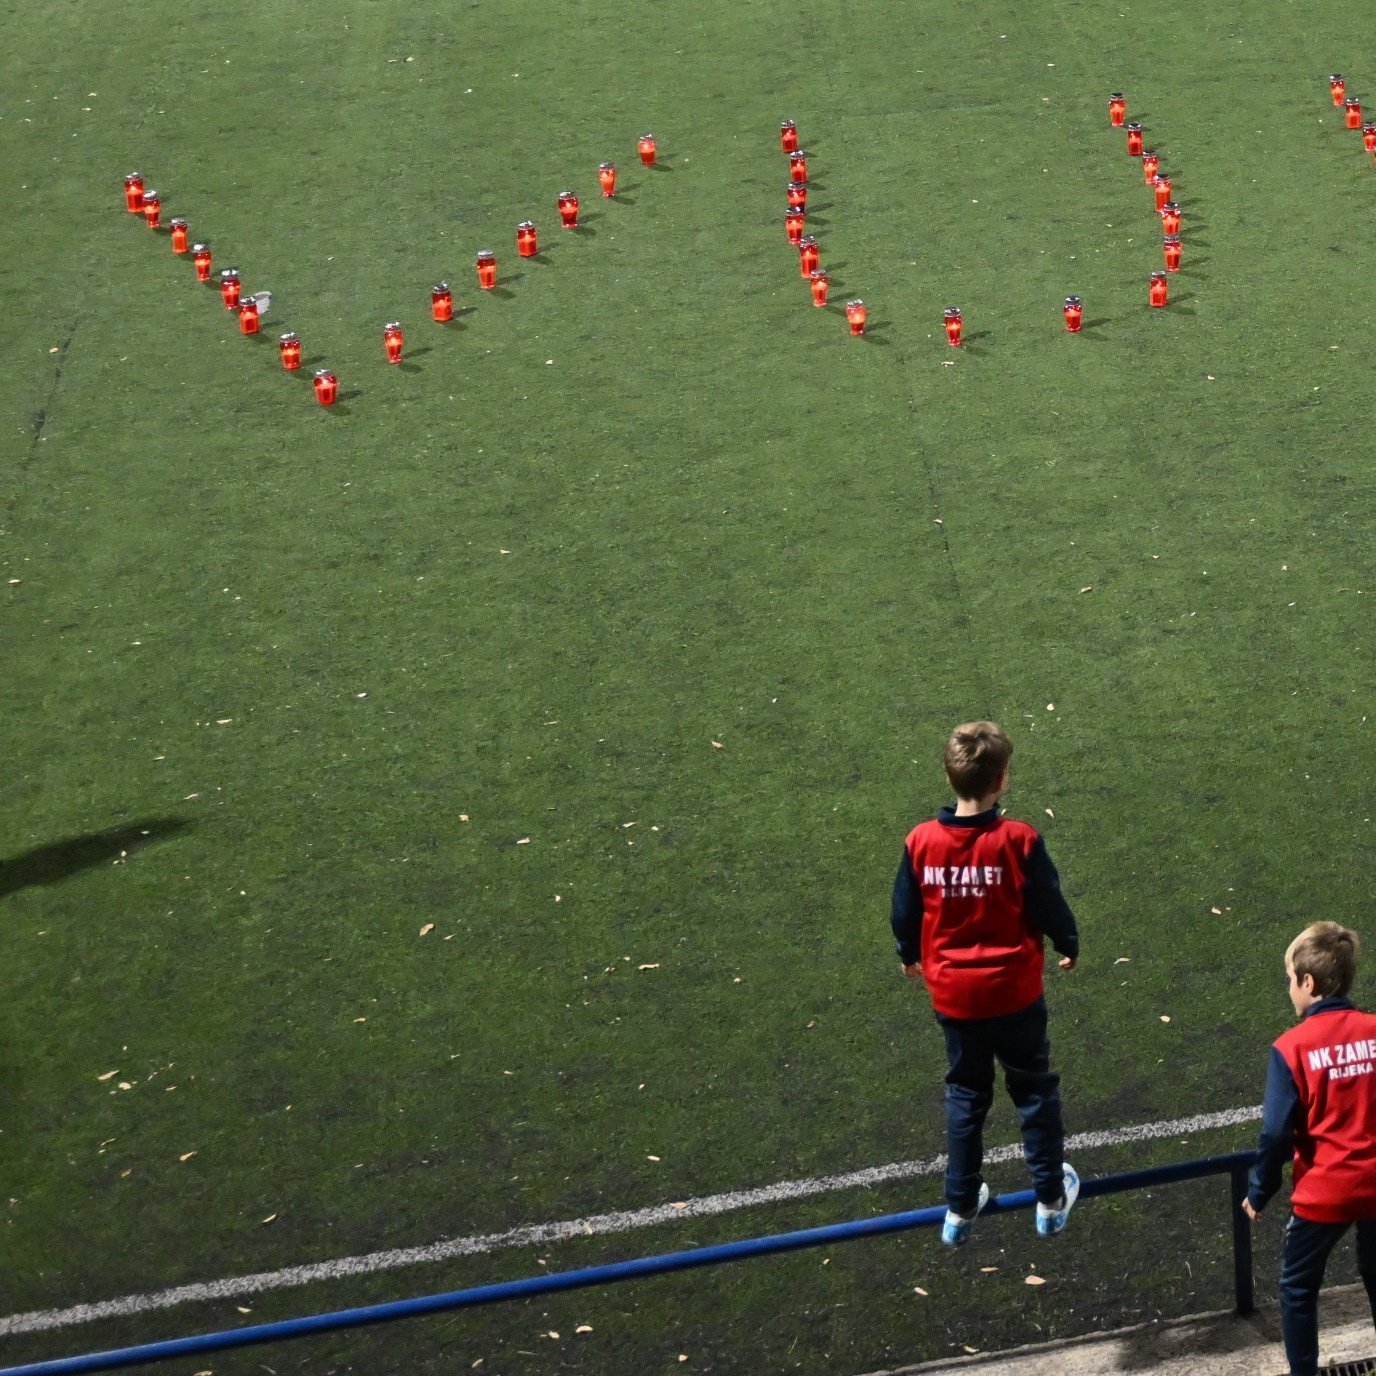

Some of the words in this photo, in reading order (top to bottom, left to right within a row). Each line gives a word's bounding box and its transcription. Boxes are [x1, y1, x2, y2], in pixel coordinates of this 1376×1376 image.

[924, 865, 946, 886] NK
[1307, 1046, 1333, 1071] NK
[1328, 1062, 1374, 1080] RIJEKA
